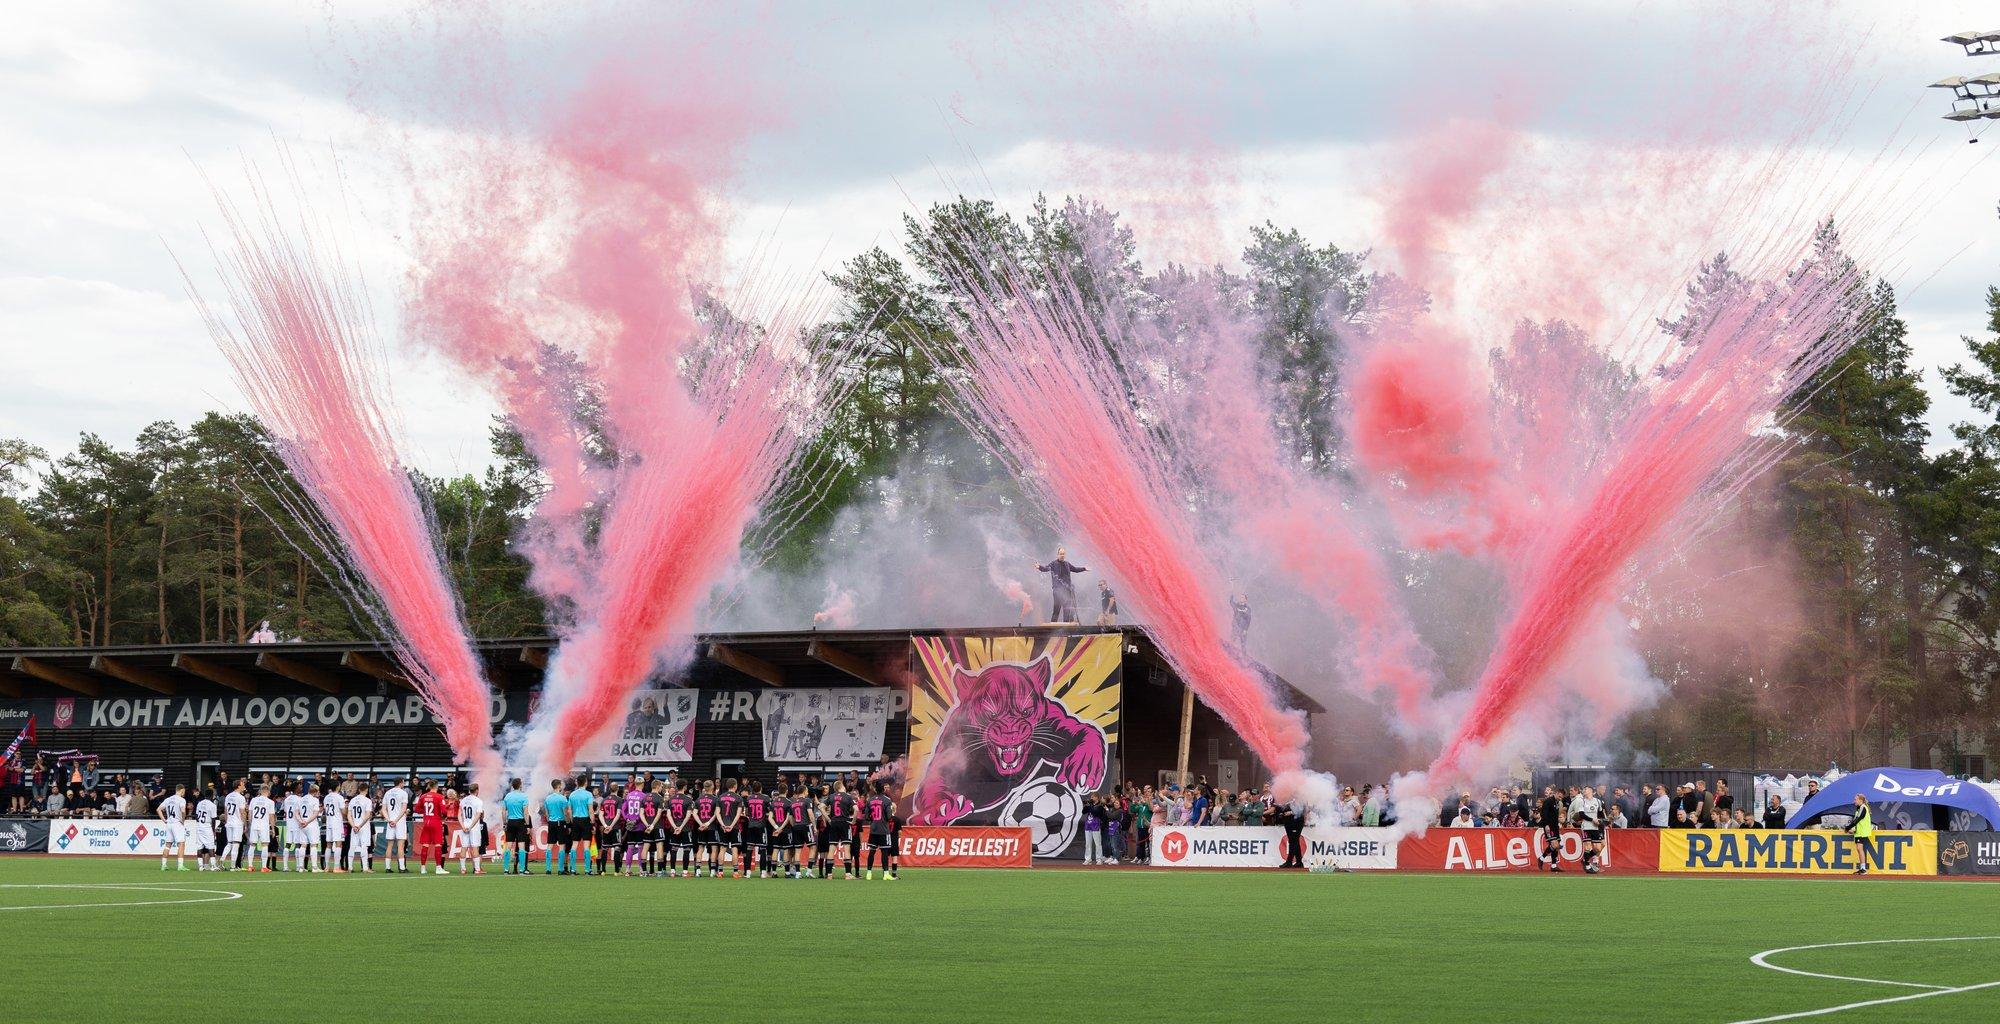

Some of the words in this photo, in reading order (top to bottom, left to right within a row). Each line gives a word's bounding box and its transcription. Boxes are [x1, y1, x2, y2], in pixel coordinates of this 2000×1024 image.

[90, 699, 171, 727] KOHT
[174, 697, 310, 726] AJALOOS
[317, 696, 424, 725] OOTAB
[633, 726, 663, 740] ARE
[612, 743, 658, 757] BACK!
[1873, 773, 1961, 797] Delfi
[167, 804, 176, 819] 14
[227, 802, 237, 816] 27
[301, 805, 308, 818] 2
[326, 803, 335, 817] 23
[389, 798, 396, 811] 9
[424, 801, 434, 816] 12
[628, 800, 640, 815] 69
[834, 800, 841, 816] 6
[254, 805, 267, 819] 29
[353, 805, 362, 819] 19
[463, 806, 473, 820] 10
[82, 828, 119, 837] Domino's
[89, 838, 111, 847] Pizza
[915, 838, 946, 856] OSA
[949, 838, 1019, 857] SELLEST!
[1193, 840, 1270, 855] MARSBET
[1686, 834, 1913, 870] RAMIRENT
